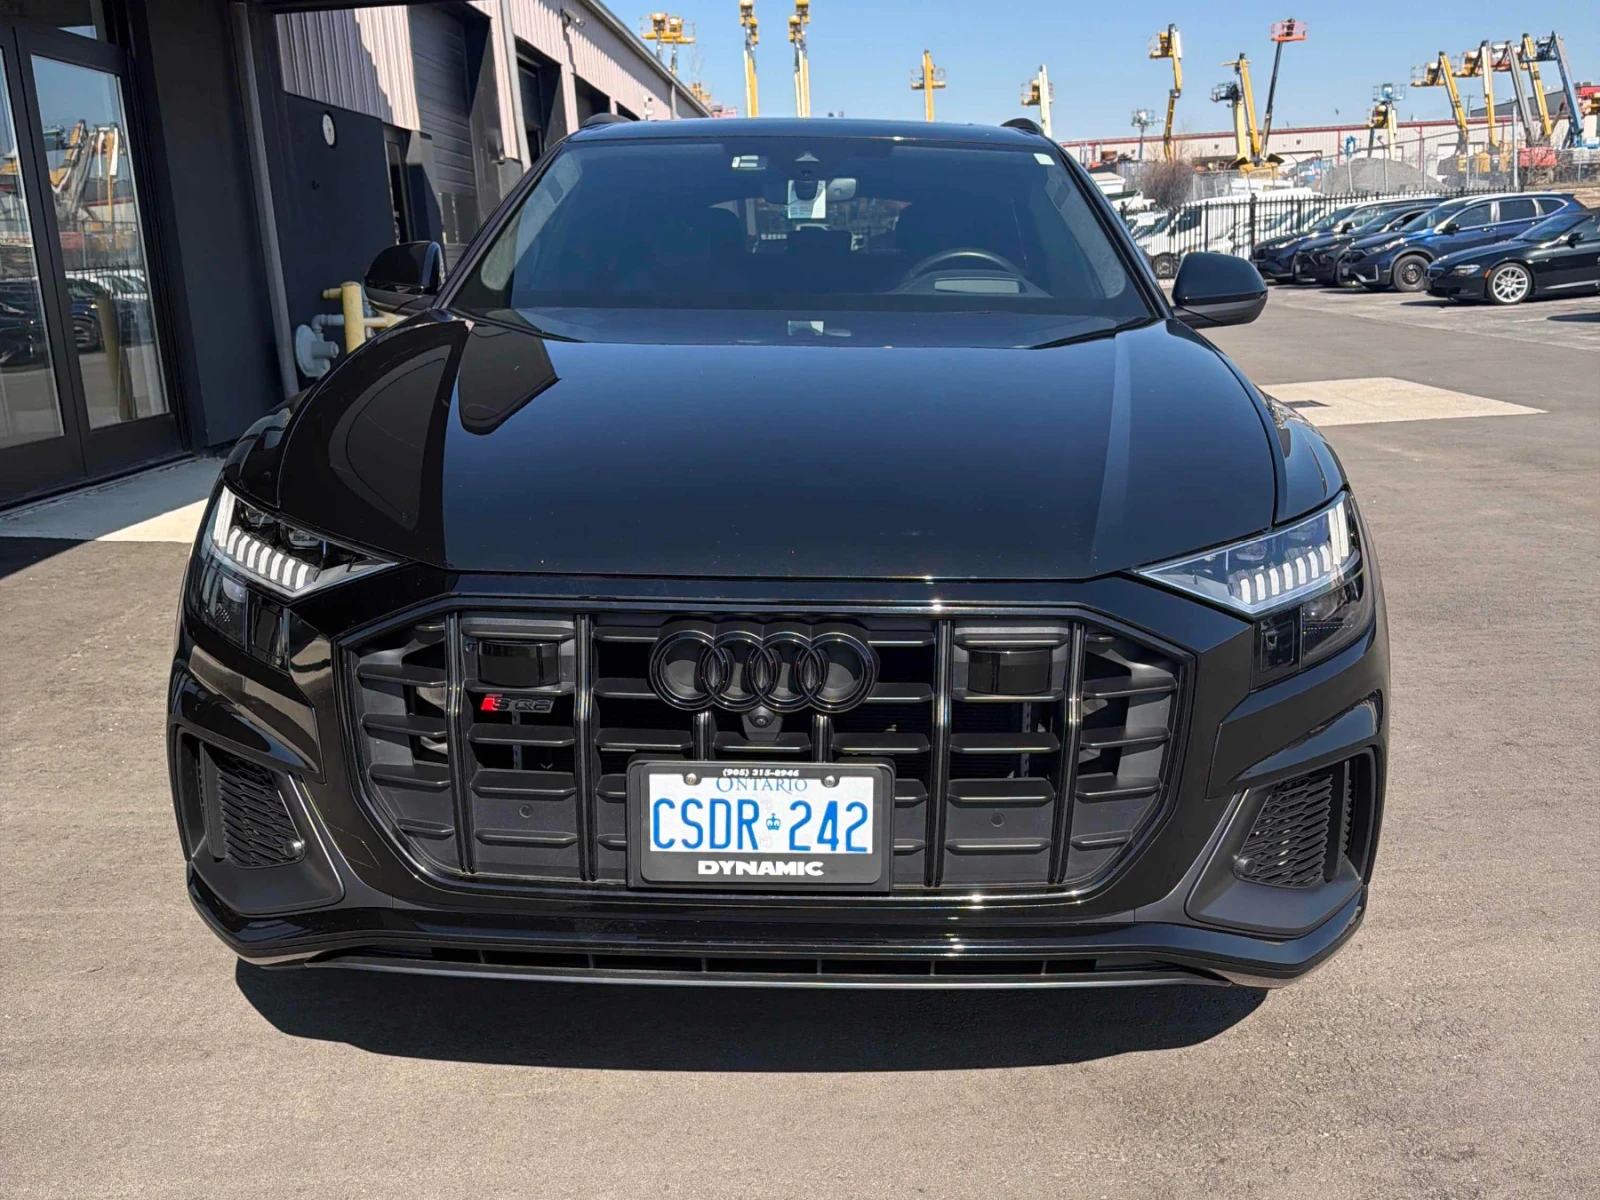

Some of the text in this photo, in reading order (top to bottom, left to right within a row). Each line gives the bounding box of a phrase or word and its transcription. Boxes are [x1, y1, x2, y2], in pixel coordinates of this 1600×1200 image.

[722, 768, 750, 777] (905)
[716, 776, 808, 795] ONTARIO
[653, 798, 868, 853] CSDR 242
[698, 860, 825, 877] DYNAMIC
